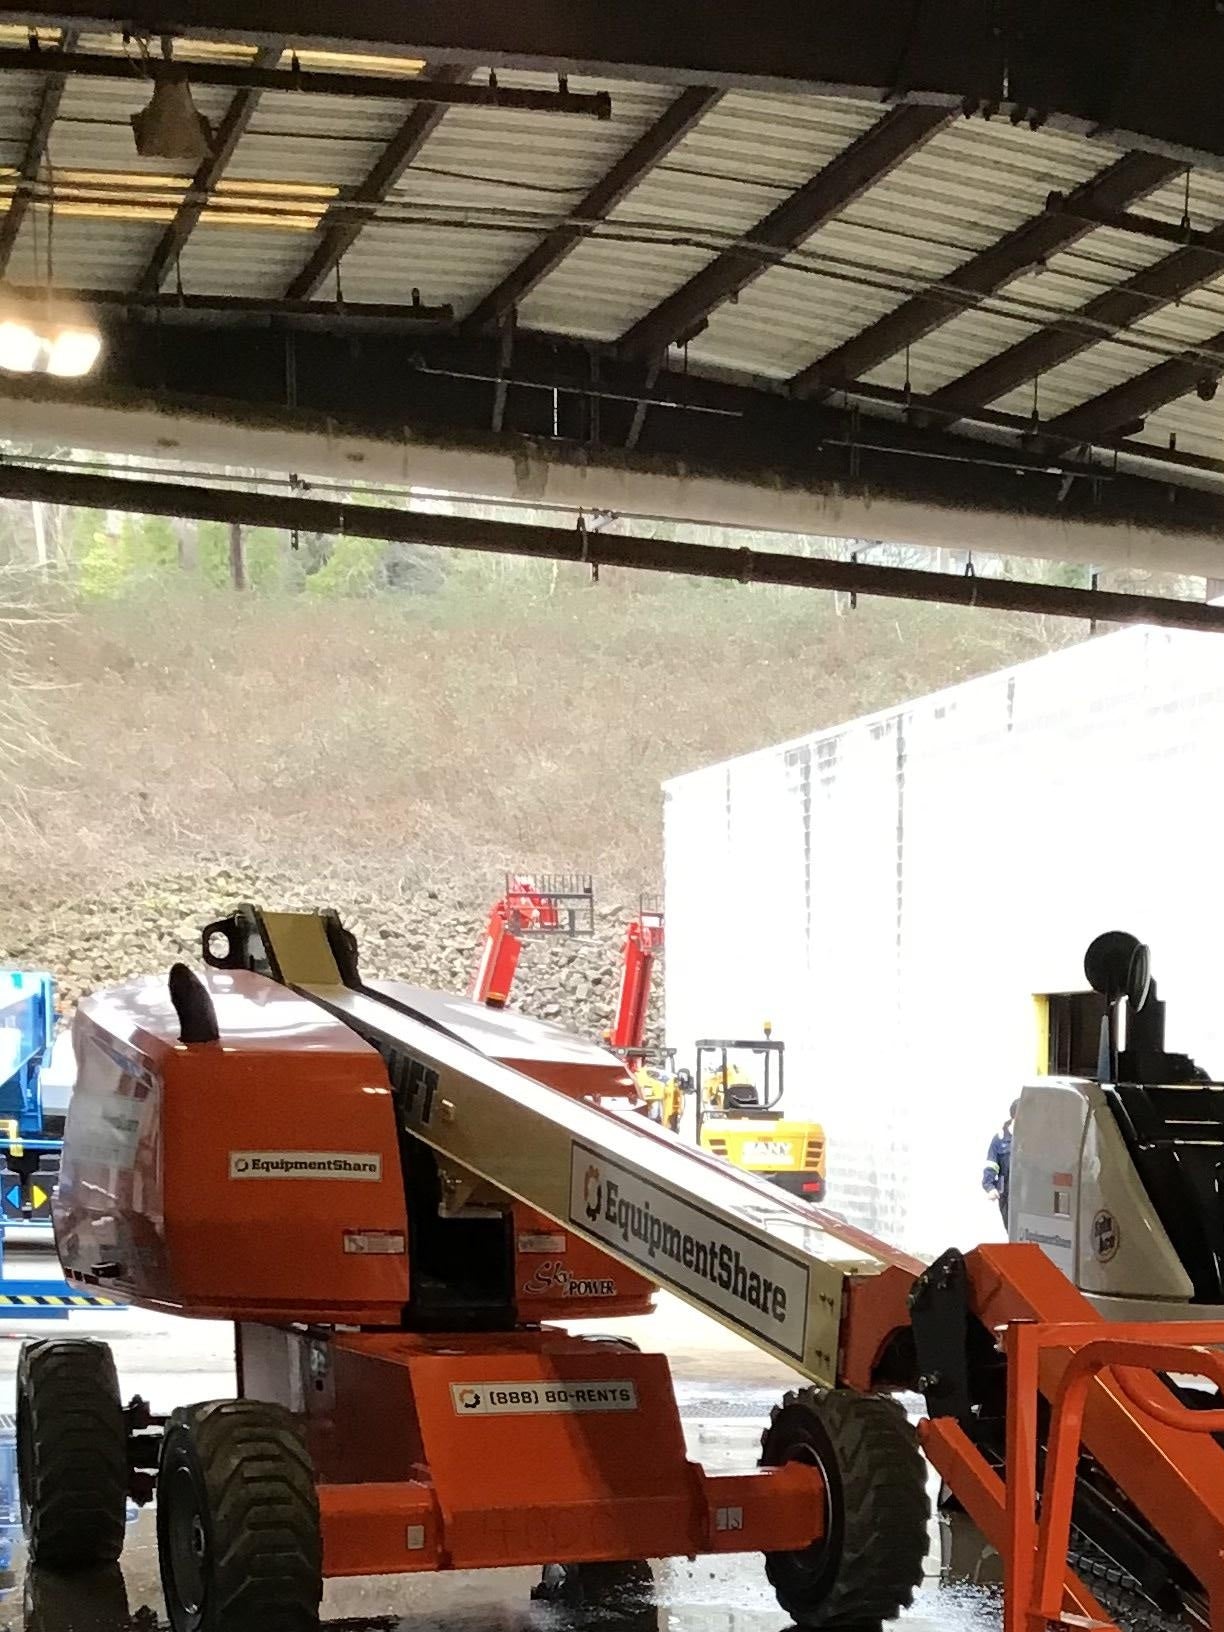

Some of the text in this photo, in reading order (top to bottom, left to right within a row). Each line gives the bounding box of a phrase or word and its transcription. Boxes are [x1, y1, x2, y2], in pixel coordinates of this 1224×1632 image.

[251, 1158, 378, 1174] EquipmentShare
[605, 1179, 788, 1324] EquipmentShare
[568, 1280, 616, 1296] POWER
[489, 1388, 632, 1406] (888) 80-RENTS
